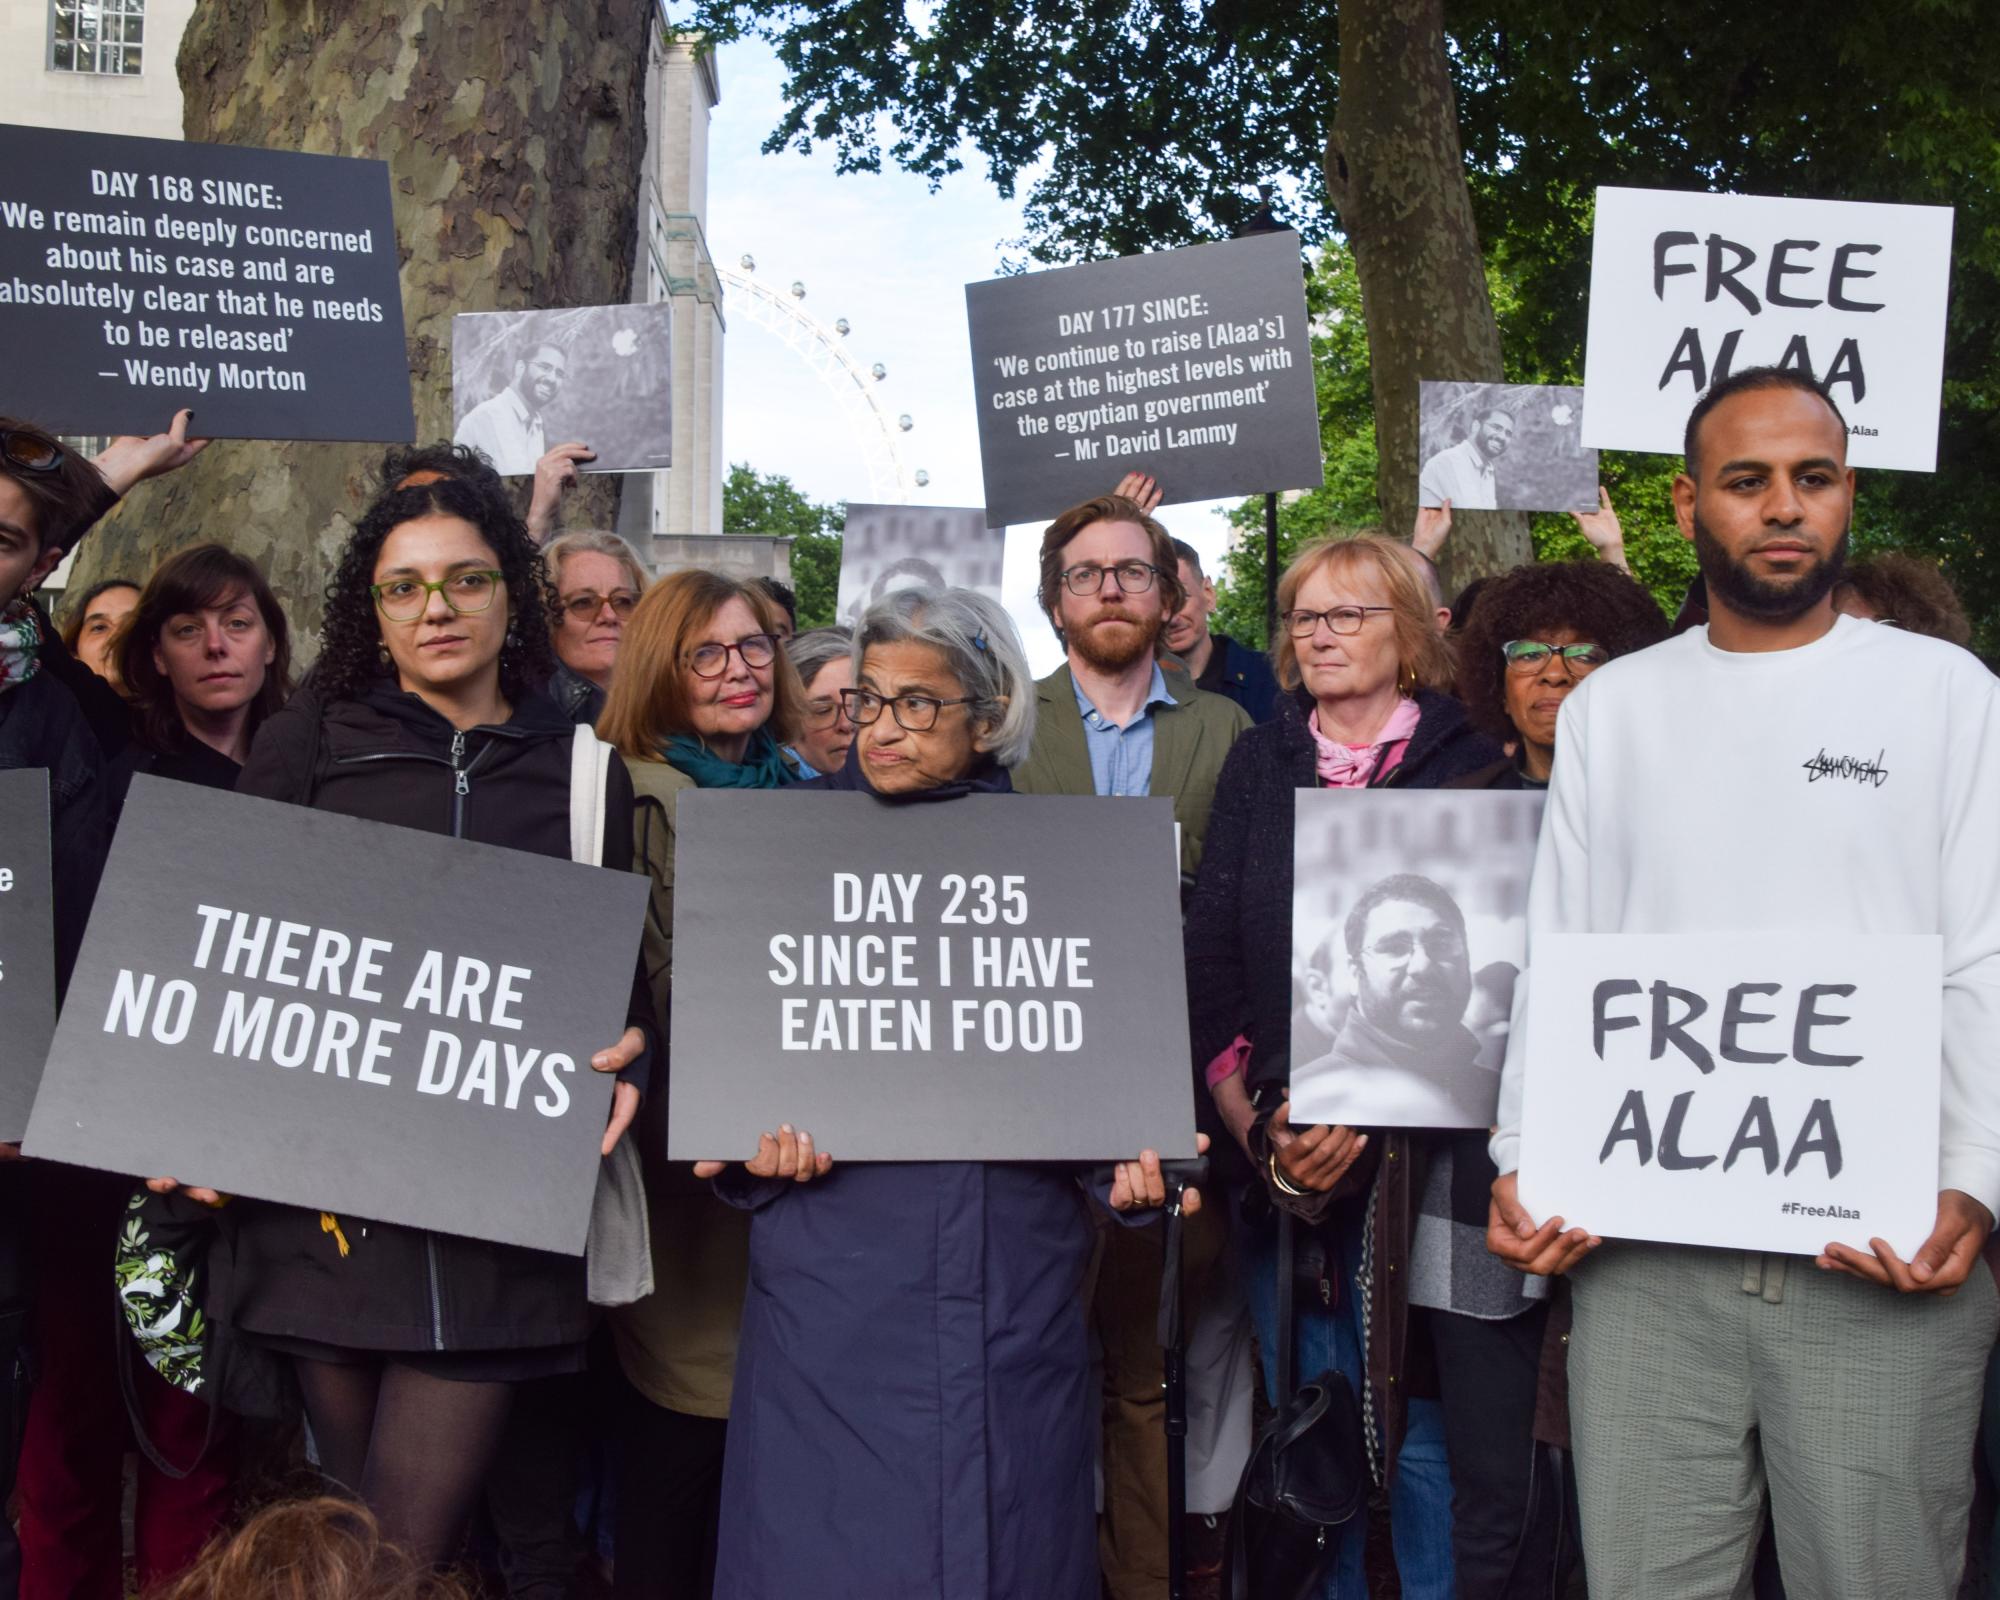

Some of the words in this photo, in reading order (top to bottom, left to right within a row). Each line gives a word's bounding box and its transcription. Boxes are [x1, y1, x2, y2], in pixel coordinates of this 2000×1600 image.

[91, 169, 139, 198] DAY
[148, 174, 194, 203] 168
[201, 179, 283, 210] SINCE:
[53, 210, 146, 237] remain
[154, 213, 237, 248] deeply
[245, 225, 373, 254] concerned
[46, 242, 122, 272] about
[129, 246, 168, 275] his
[175, 255, 235, 279] case
[242, 256, 288, 283] and
[295, 263, 335, 285] are
[1653, 230, 1886, 316] FREE
[0, 277, 135, 314] absolutely
[143, 284, 210, 313] clear
[216, 287, 268, 317] that
[273, 291, 304, 319] he
[312, 296, 384, 323] needs
[1058, 310, 1094, 337] DAY
[1101, 303, 1135, 330] 177
[1142, 294, 1209, 324] SINCE:
[103, 320, 130, 346] to
[138, 320, 170, 348] be
[1035, 344, 1120, 374] continue
[1124, 338, 1146, 359] to
[1151, 330, 1202, 356] raise
[124, 358, 211, 393] Wendy
[218, 362, 306, 392] Morton
[992, 386, 1038, 411] case
[1044, 380, 1064, 403] at
[1067, 375, 1100, 399] the
[1105, 365, 1179, 397] highest
[1184, 355, 1244, 383] levels
[1248, 346, 1292, 374] with
[1017, 412, 1049, 438] the
[1055, 402, 1139, 435] egyptian
[1074, 438, 1100, 461] Mr
[1105, 428, 1161, 458] David
[1166, 423, 1238, 450] Lammy
[833, 872, 923, 923] DAY
[940, 873, 1028, 926] 235
[193, 904, 393, 1003] THERE
[403, 950, 532, 1031] ARE
[767, 933, 919, 987] SINCE
[939, 936, 951, 987] I
[972, 936, 1094, 988] HAVE
[102, 969, 198, 1046] NO
[212, 990, 402, 1087] MORE
[416, 1029, 576, 1119] DAYS
[781, 997, 932, 1052] EATEN
[952, 999, 1083, 1053] FOOD
[1592, 978, 1864, 1075] FREE
[1598, 1088, 1844, 1180] ALAA
[1781, 1202, 1861, 1220] #FreeAlaa
